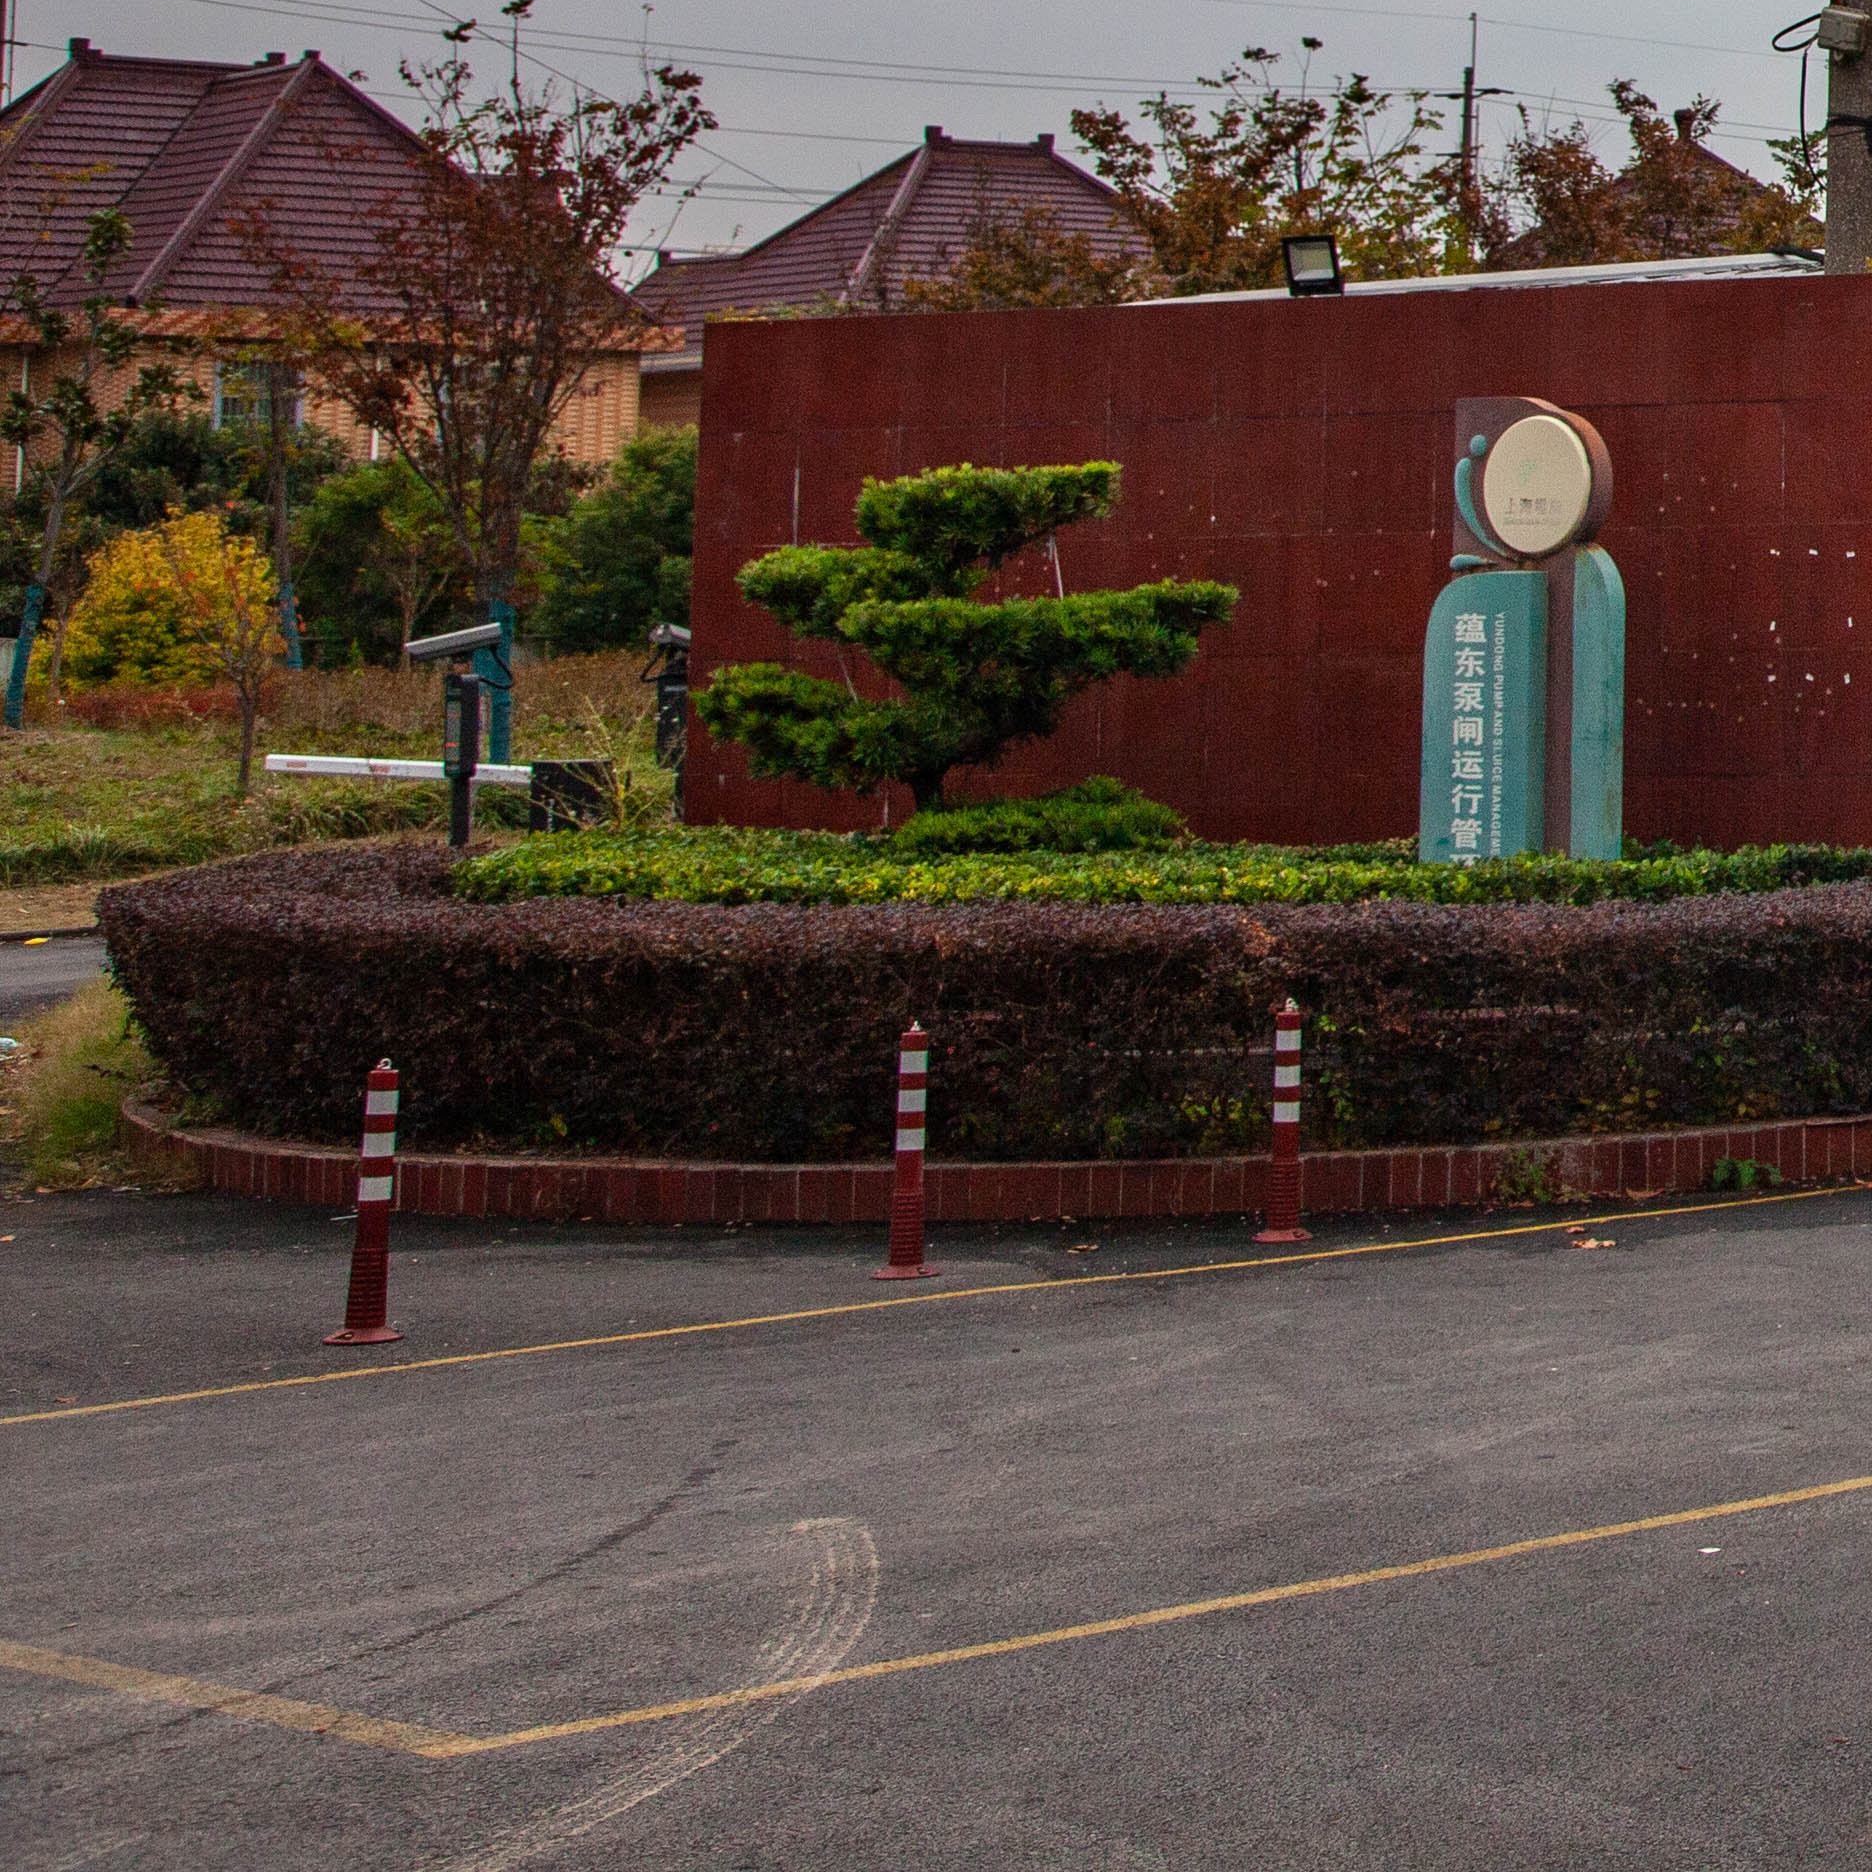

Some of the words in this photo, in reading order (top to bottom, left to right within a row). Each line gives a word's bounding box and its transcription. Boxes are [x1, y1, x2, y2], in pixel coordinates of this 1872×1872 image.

[1493, 612, 1507, 672] YUNDONG
[1493, 674, 1504, 709] PUMP
[1492, 710, 1503, 736] AND
[1491, 738, 1503, 782] SLUICE
